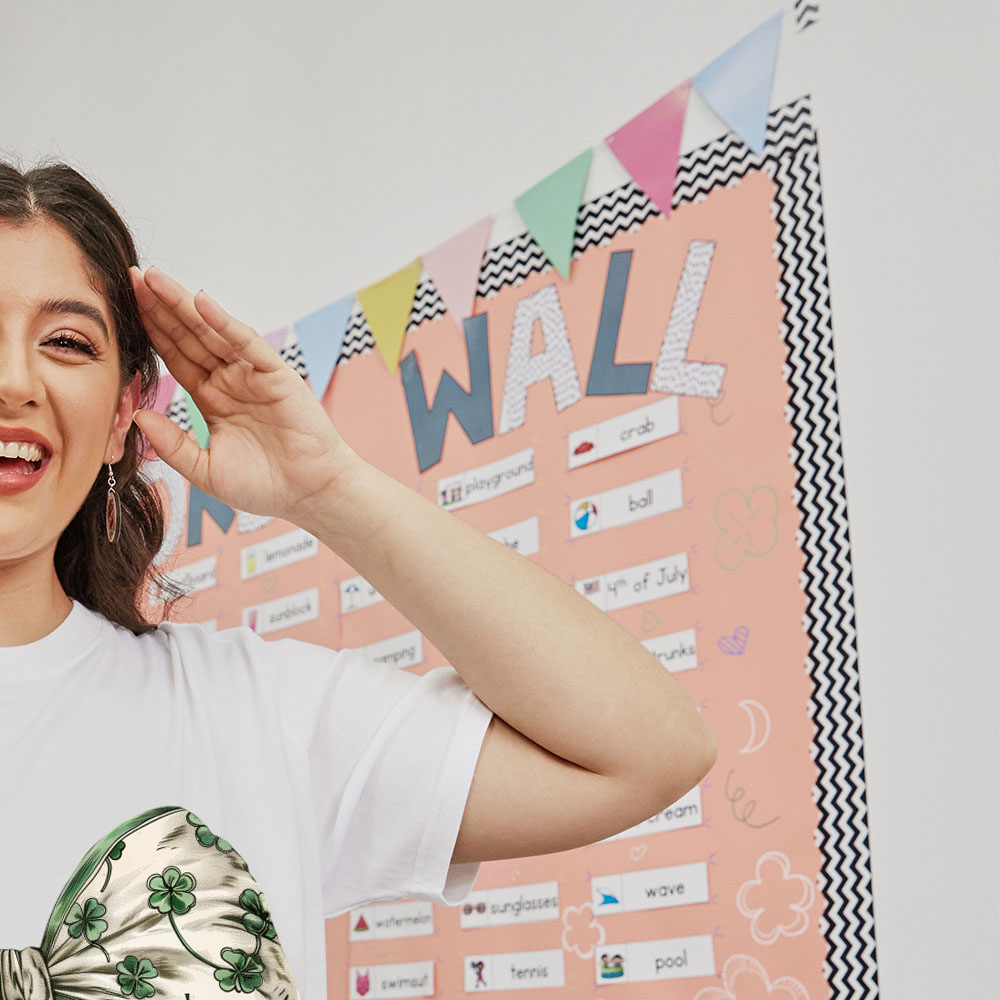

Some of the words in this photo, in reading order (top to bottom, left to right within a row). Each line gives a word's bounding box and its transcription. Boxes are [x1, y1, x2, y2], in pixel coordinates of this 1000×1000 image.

[399, 240, 727, 473] WALL
[620, 417, 656, 441] crab
[464, 459, 534, 497] playground
[628, 488, 653, 512] ball
[266, 536, 314, 562] lemonade
[633, 572, 651, 592] of
[657, 565, 688, 588] July
[644, 883, 685, 899] wave
[490, 895, 558, 917] sunglasses
[375, 909, 434, 928] watermelon
[510, 965, 549, 980] tennis
[655, 957, 688, 974] pool
